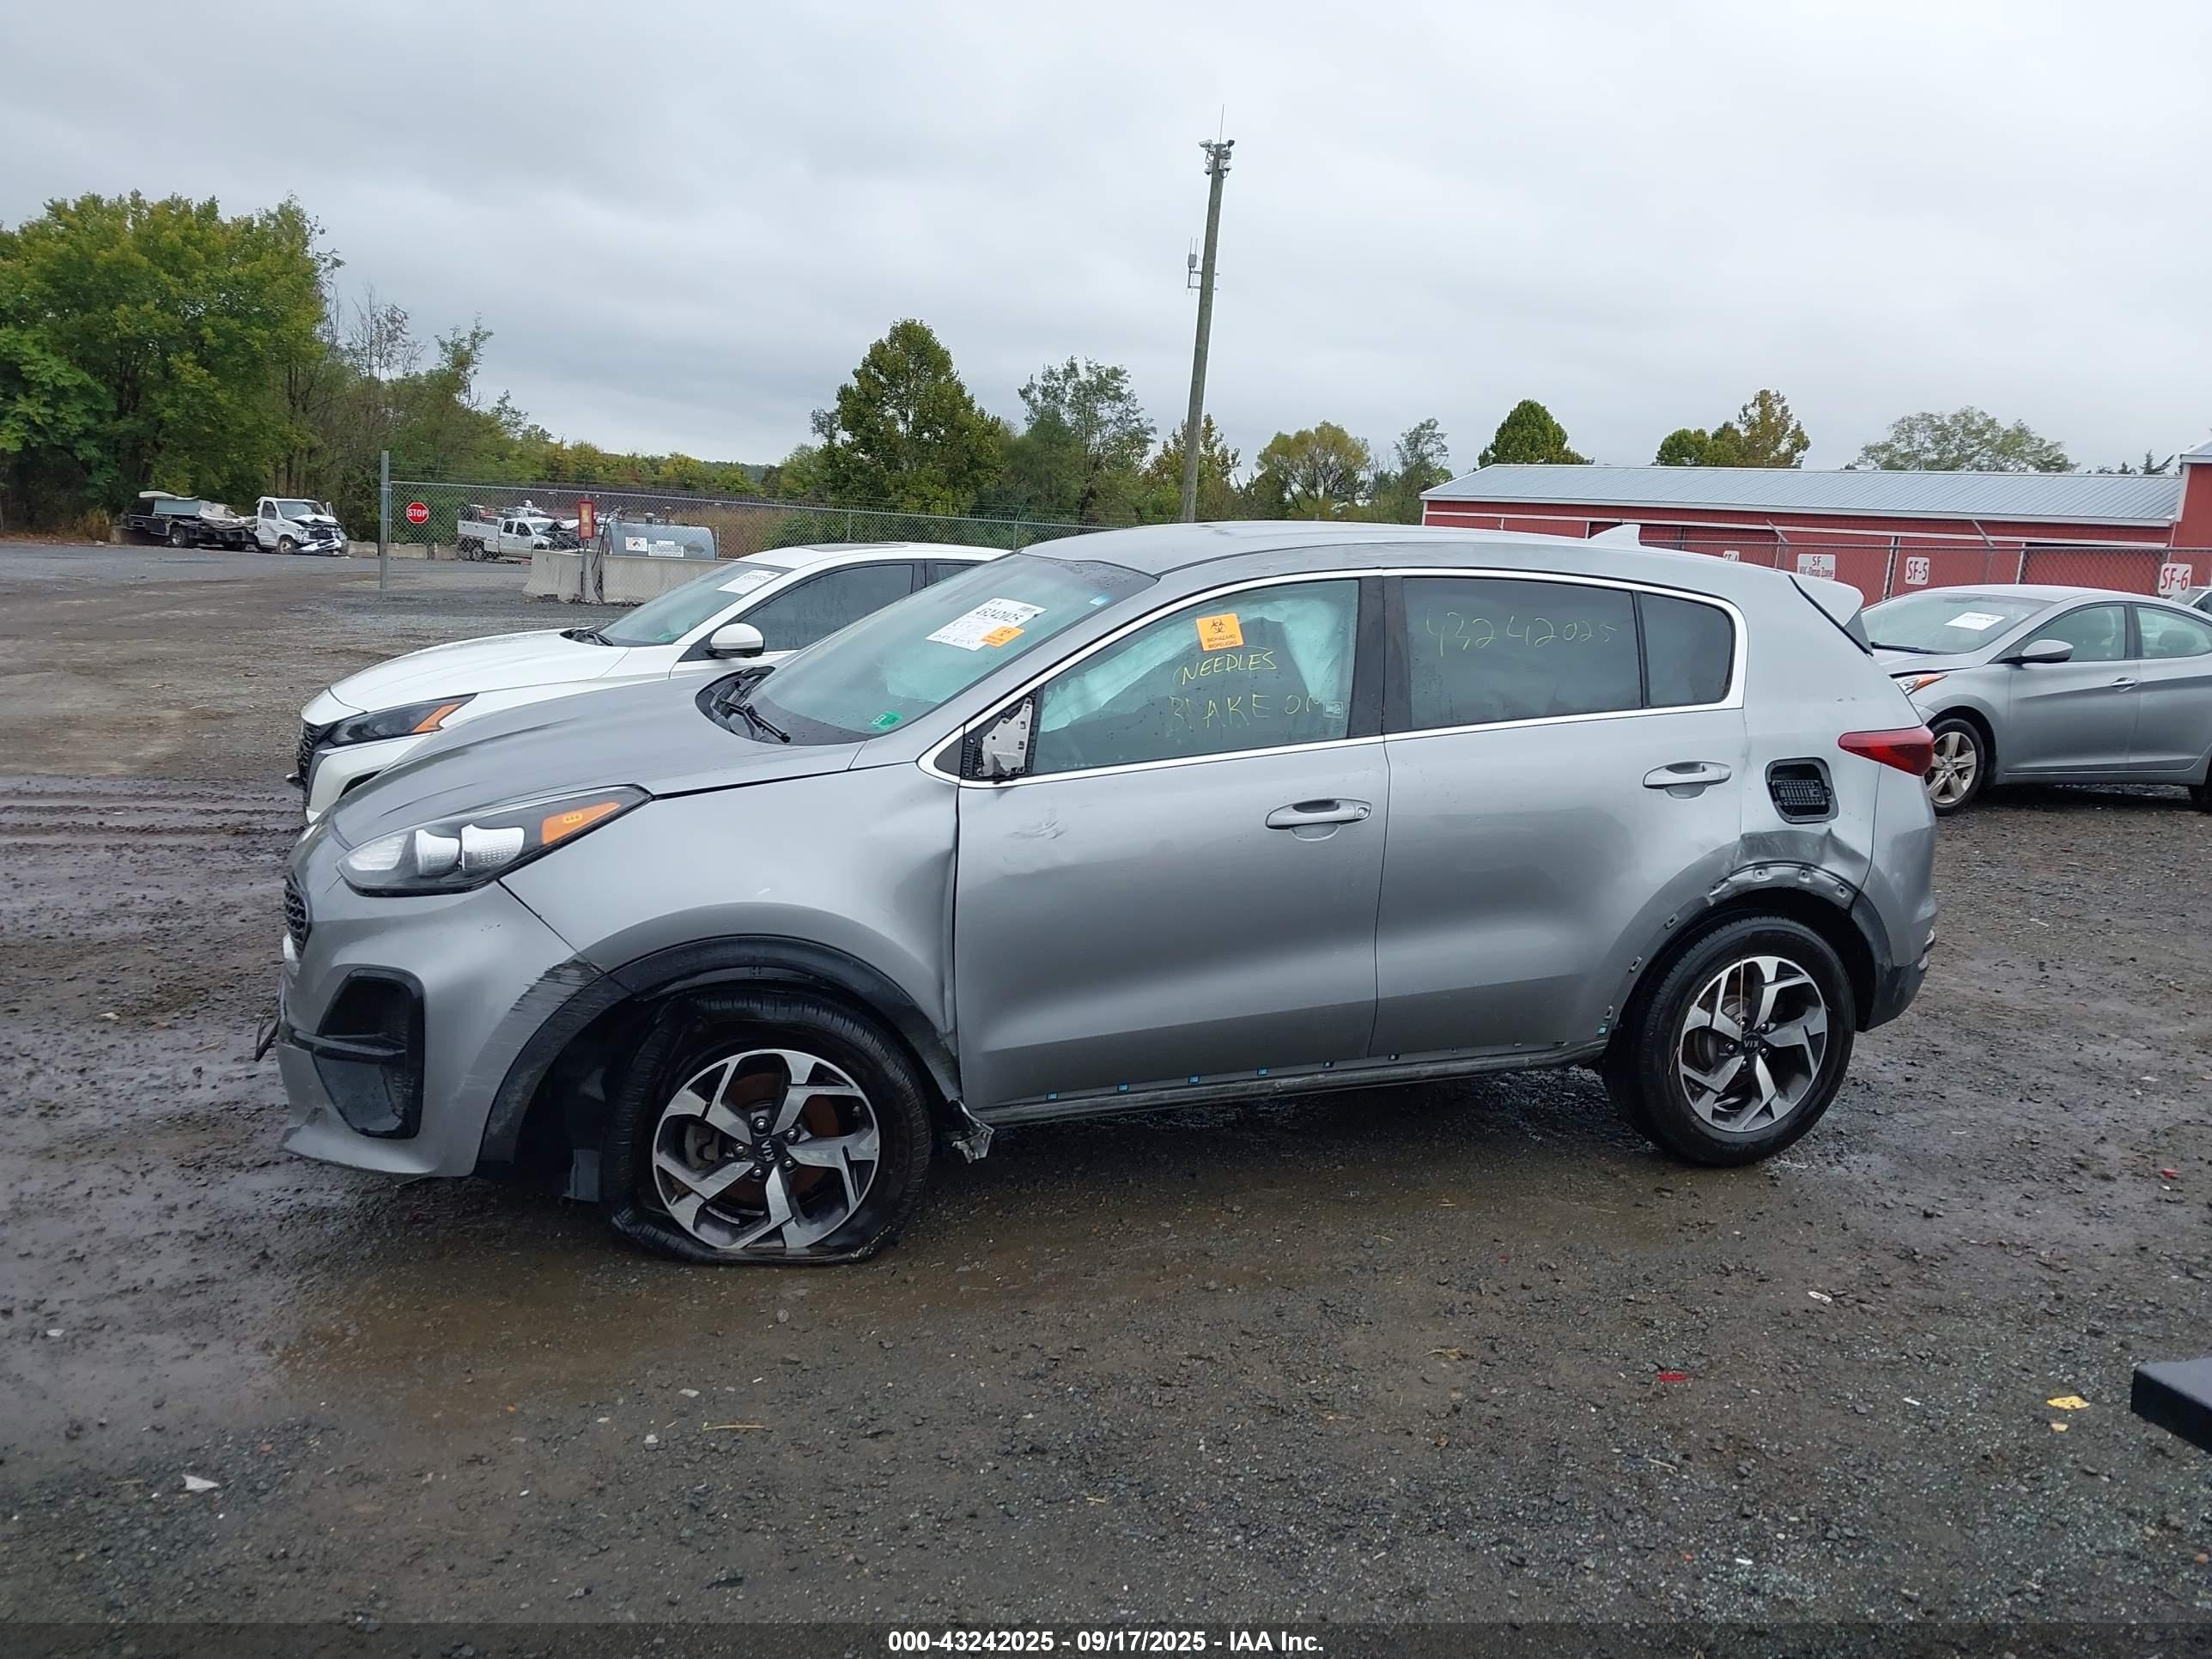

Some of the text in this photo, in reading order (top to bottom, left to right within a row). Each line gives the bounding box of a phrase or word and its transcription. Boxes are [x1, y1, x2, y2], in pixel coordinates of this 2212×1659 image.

[1812, 556, 1822, 566] SF
[1906, 560, 1929, 580] SF-5
[1821, 566, 1834, 578] Zone
[2160, 567, 2190, 592] SF-6
[1206, 633, 1237, 643] BIOHAZARD
[1425, 608, 1618, 658] 43242025
[1181, 650, 1279, 686] NEEDLES
[761, 1139, 775, 1162] KIA
